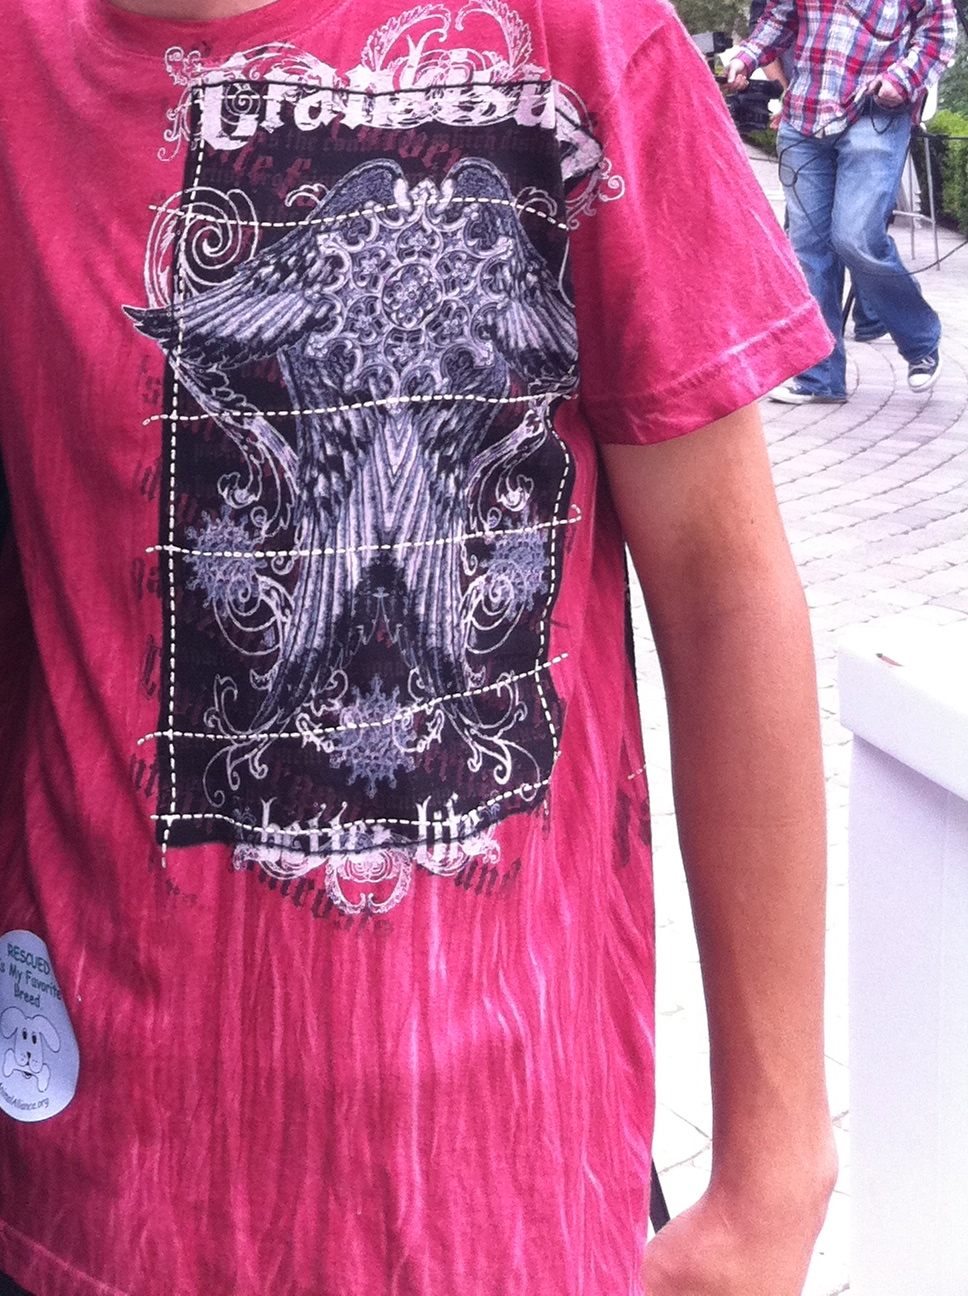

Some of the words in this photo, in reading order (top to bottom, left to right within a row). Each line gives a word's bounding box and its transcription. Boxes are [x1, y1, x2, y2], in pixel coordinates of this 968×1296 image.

[7, 942, 51, 976] RESCUED
[9, 962, 23, 985] My
[25, 969, 62, 1001] Favorite
